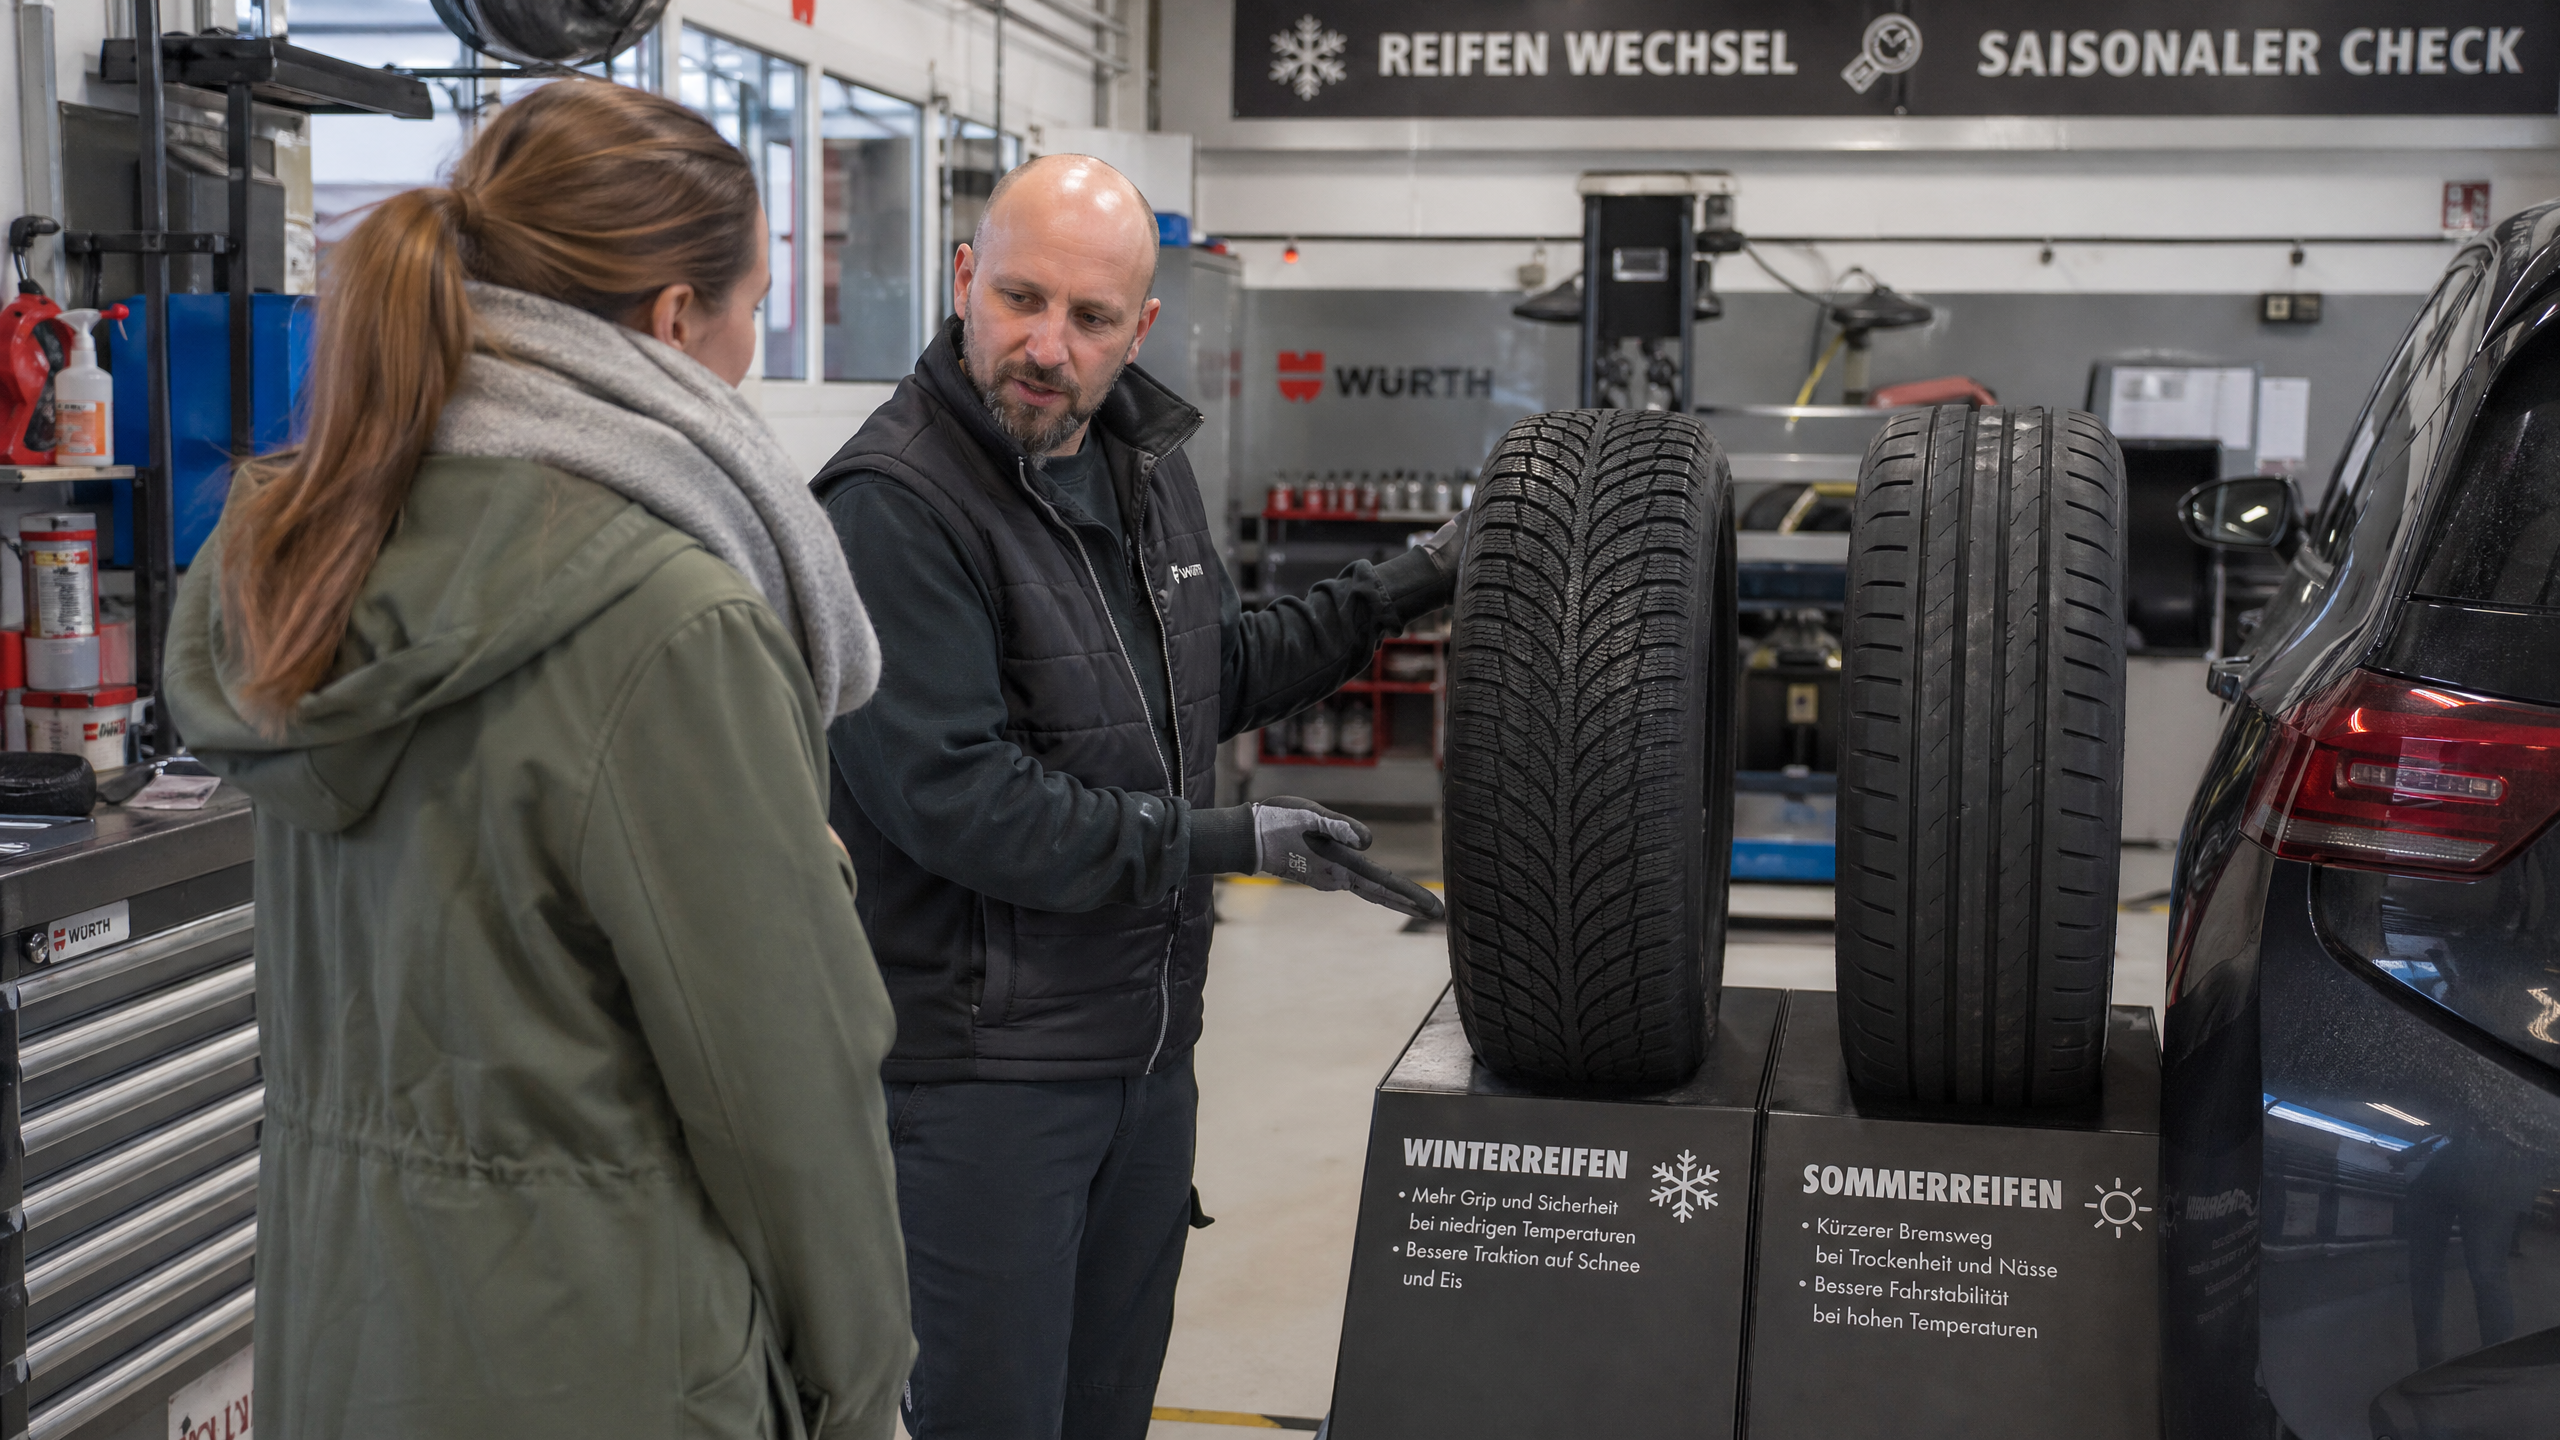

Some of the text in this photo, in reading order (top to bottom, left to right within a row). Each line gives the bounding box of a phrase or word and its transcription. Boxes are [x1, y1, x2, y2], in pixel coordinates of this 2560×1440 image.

[1379, 30, 1798, 77] REIFEN WECHSEL
[1977, 27, 2524, 77] SAISONALER CHECK
[1334, 366, 1493, 397] WÜRTH
[68, 918, 111, 944] WÜRTH
[1403, 1137, 1629, 1180] WINTERREIFEN
[1412, 1187, 1619, 1215] Mehr Grip und Sicherheit
[1802, 1163, 2062, 1210] SOMMERREIFEN
[1409, 1213, 1636, 1244] bei niedrigen Temperaturen
[1817, 1217, 1992, 1250] Kürzerer Bremsweg
[1406, 1241, 1641, 1274] Bessere Traktion auf Schnee
[1815, 1244, 2058, 1278] bei Trockenheit und Nässe
[1402, 1269, 1463, 1289] und Eis
[1814, 1275, 2009, 1306] Bessere Fahrstabilität
[1812, 1303, 2038, 1339] bei hohen Temperaturen
